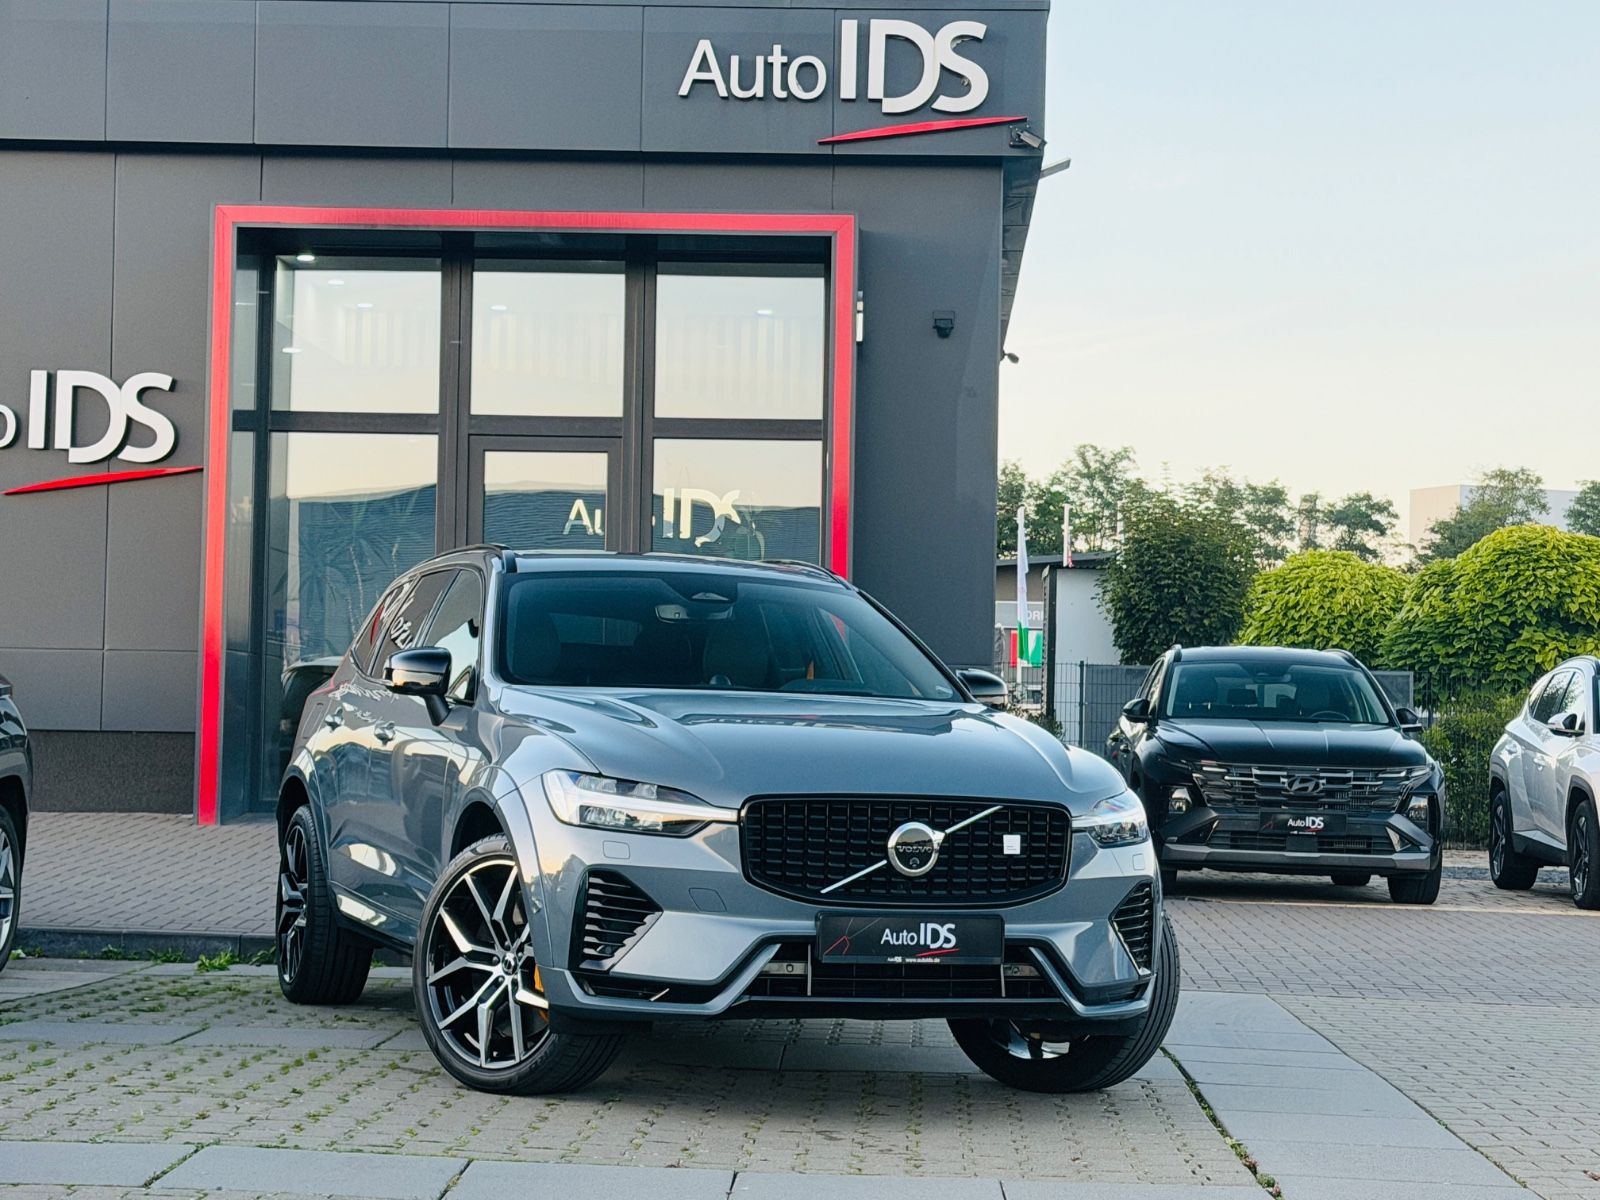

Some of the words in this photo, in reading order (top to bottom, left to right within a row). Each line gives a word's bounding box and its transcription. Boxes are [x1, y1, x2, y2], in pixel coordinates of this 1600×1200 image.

[678, 39, 827, 100] Auto
[839, 18, 989, 114] IDS
[28, 369, 175, 464] IDS
[896, 845, 933, 853] VOLVO
[880, 928, 918, 946] Auto
[919, 922, 957, 949] IDS
